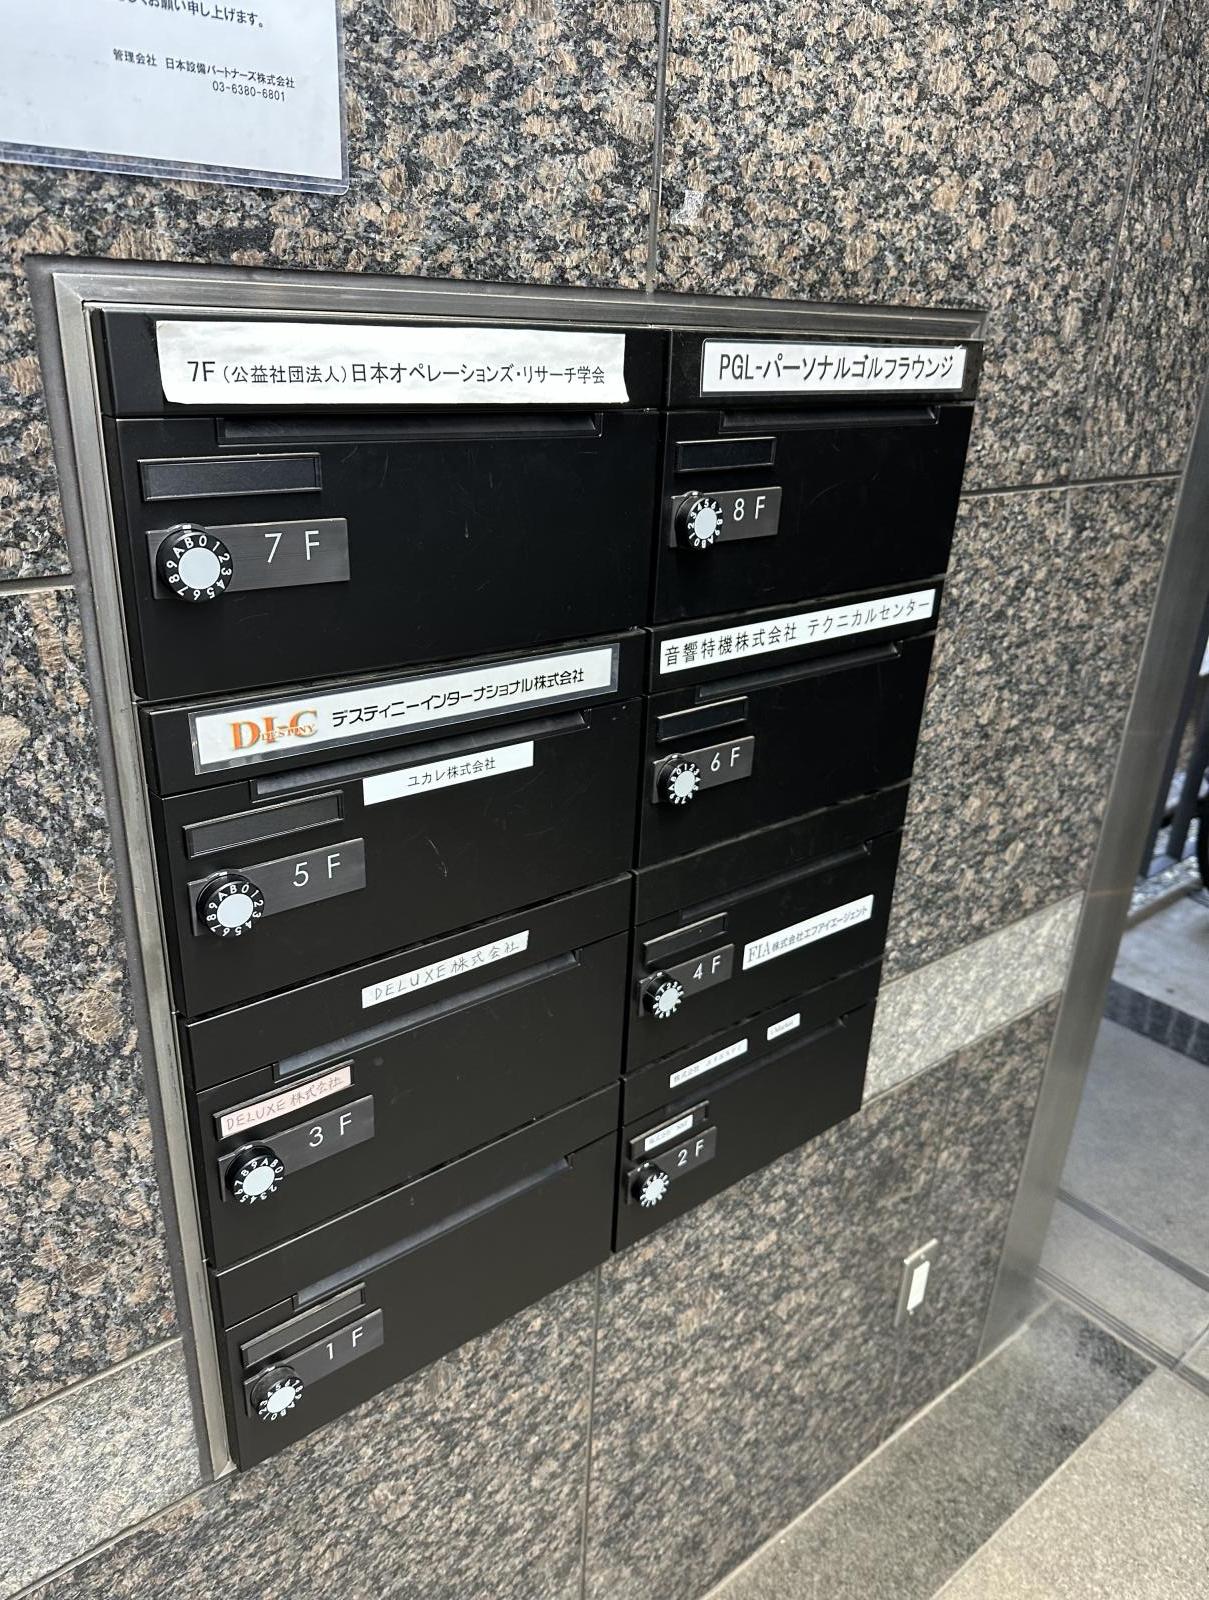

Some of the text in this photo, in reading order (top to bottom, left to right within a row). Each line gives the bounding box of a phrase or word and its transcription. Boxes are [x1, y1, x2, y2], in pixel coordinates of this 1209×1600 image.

[112, 48, 158, 67] 管理会社
[212, 80, 286, 102] 03-6380-6801
[665, 599, 931, 666] 音響特機株式会社 テクニカルセンター
[332, 668, 586, 727] デスティニーインターナショナル株式会社
[407, 756, 496, 787] ユカレ株式会社
